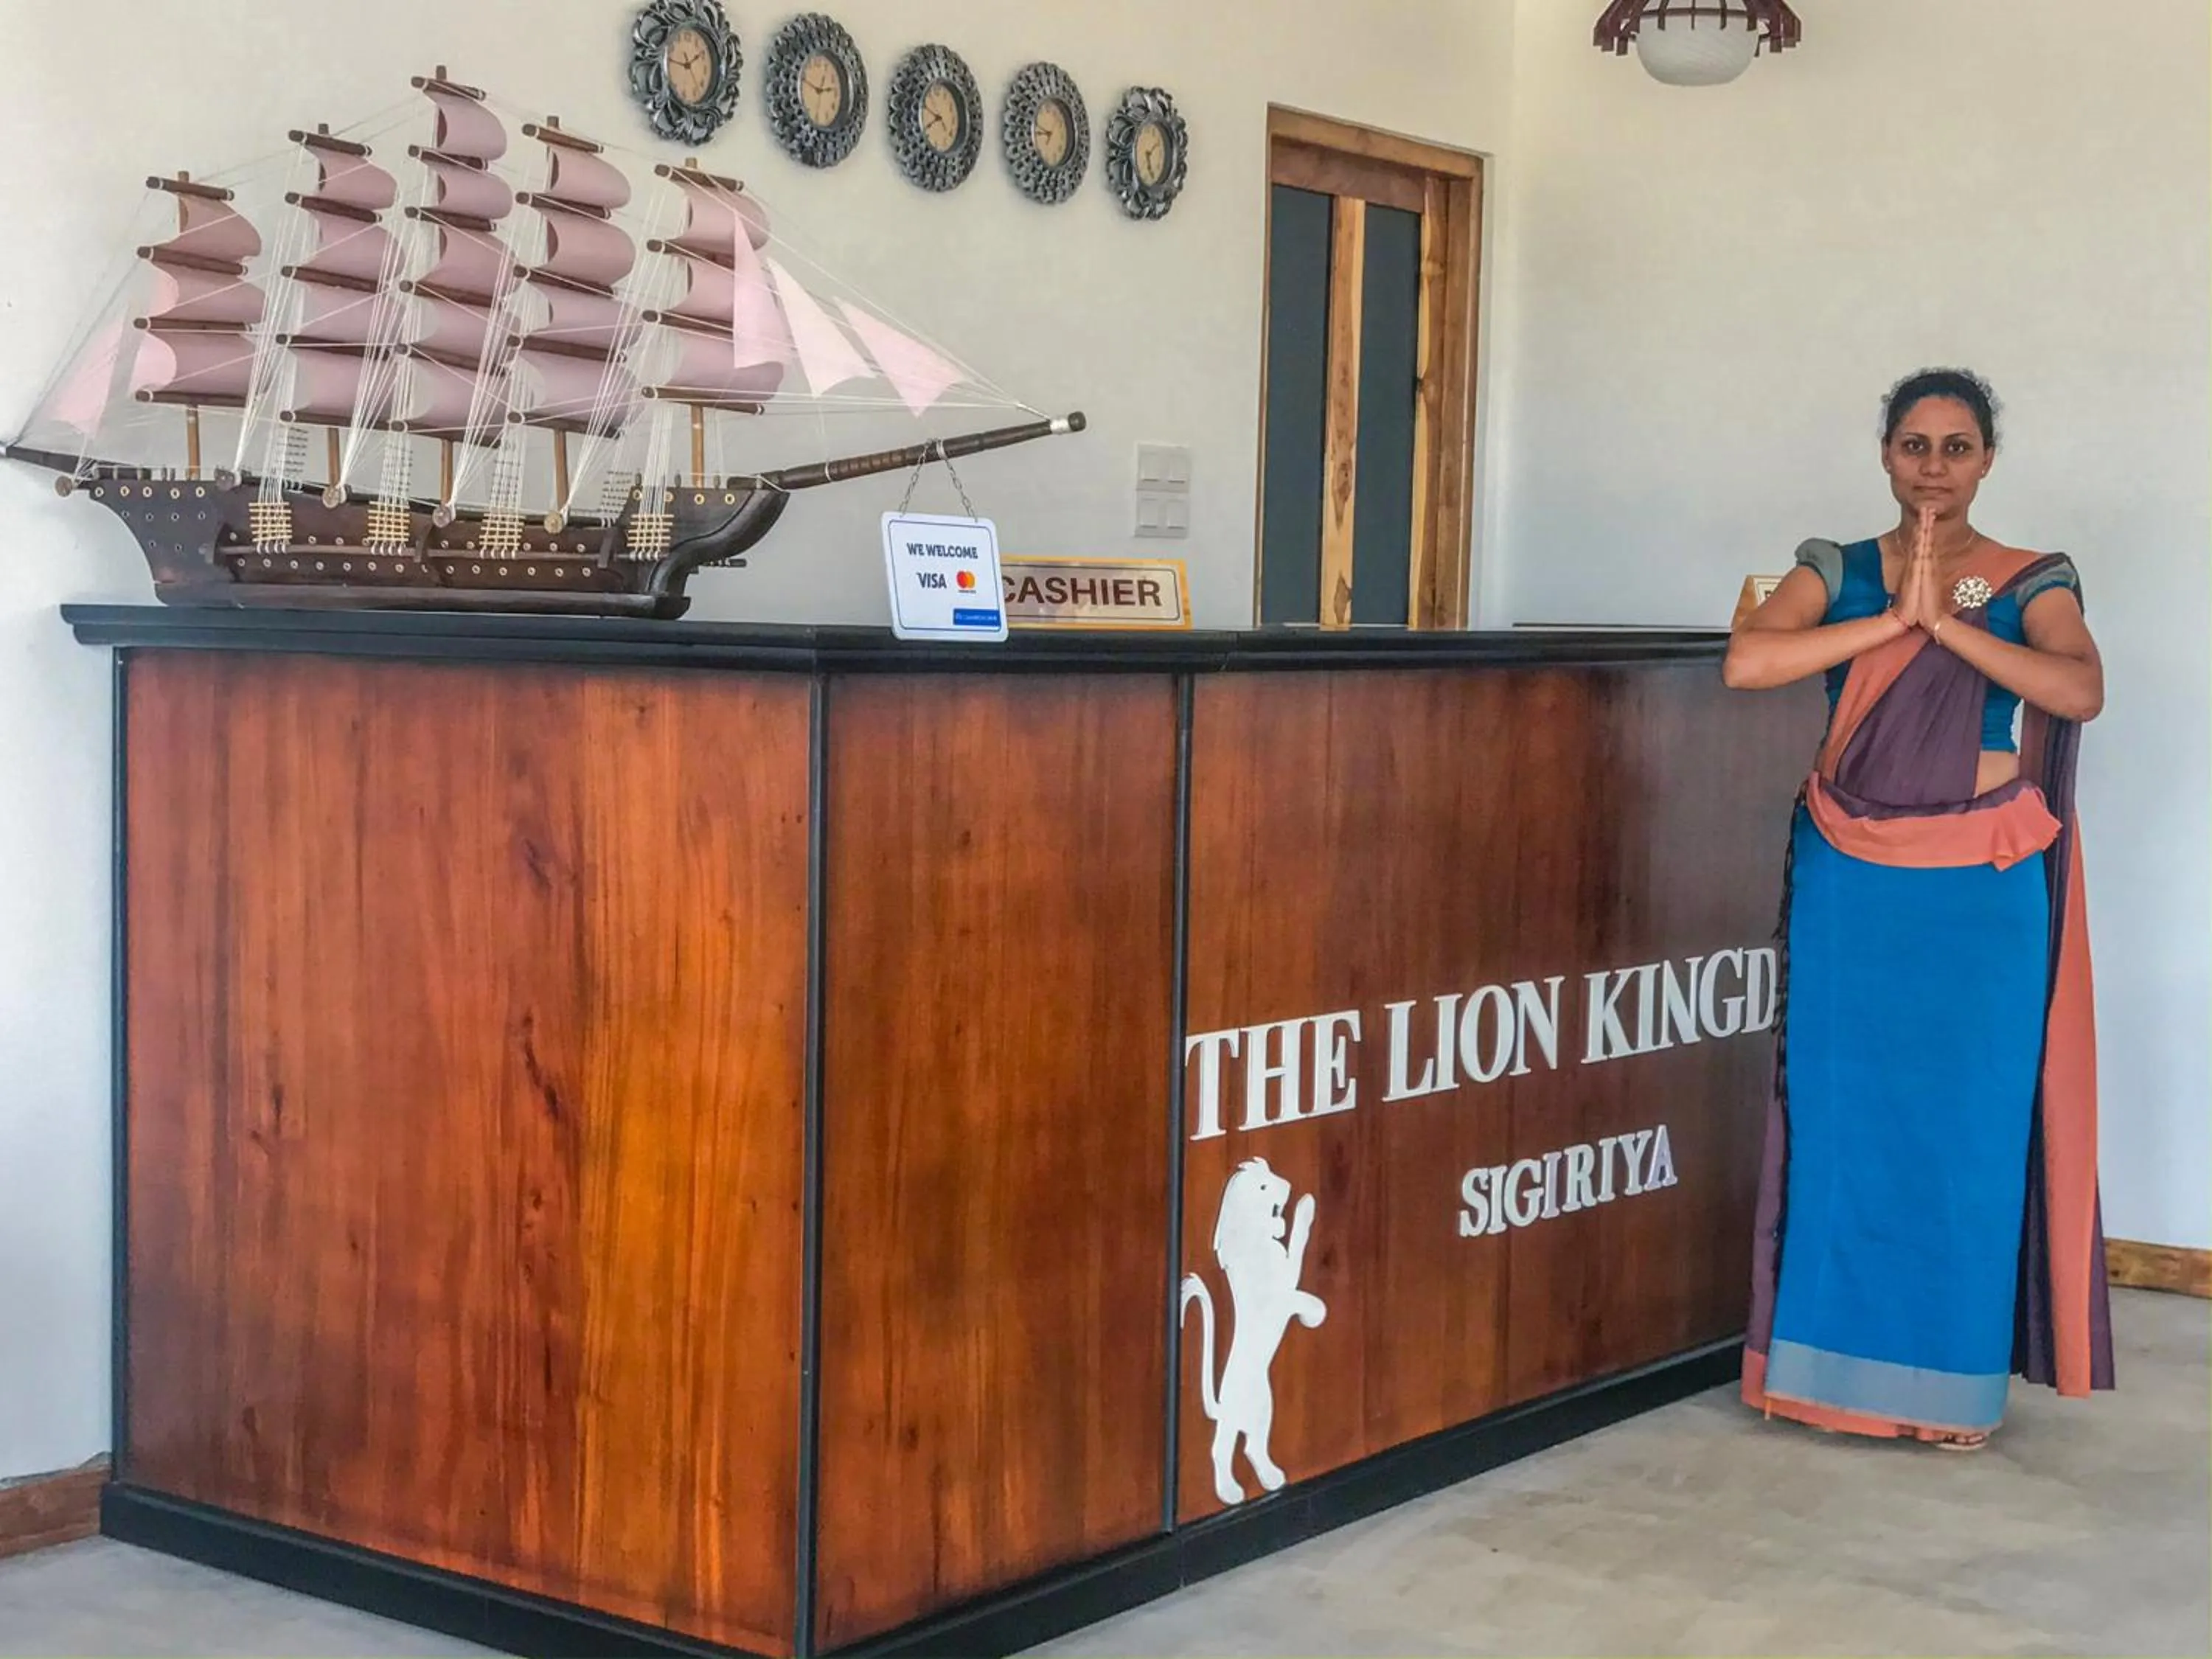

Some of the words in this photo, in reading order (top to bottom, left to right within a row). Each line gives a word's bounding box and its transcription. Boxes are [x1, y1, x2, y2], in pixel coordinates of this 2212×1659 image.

[906, 543, 925, 555] WE
[926, 544, 978, 559] WELCOME
[917, 572, 947, 588] VISA
[1002, 576, 1161, 607] CASHIER
[1185, 1009, 1361, 1141] THE
[1382, 975, 1565, 1103] LION
[1458, 1124, 1678, 1237] SIGIRIYA
